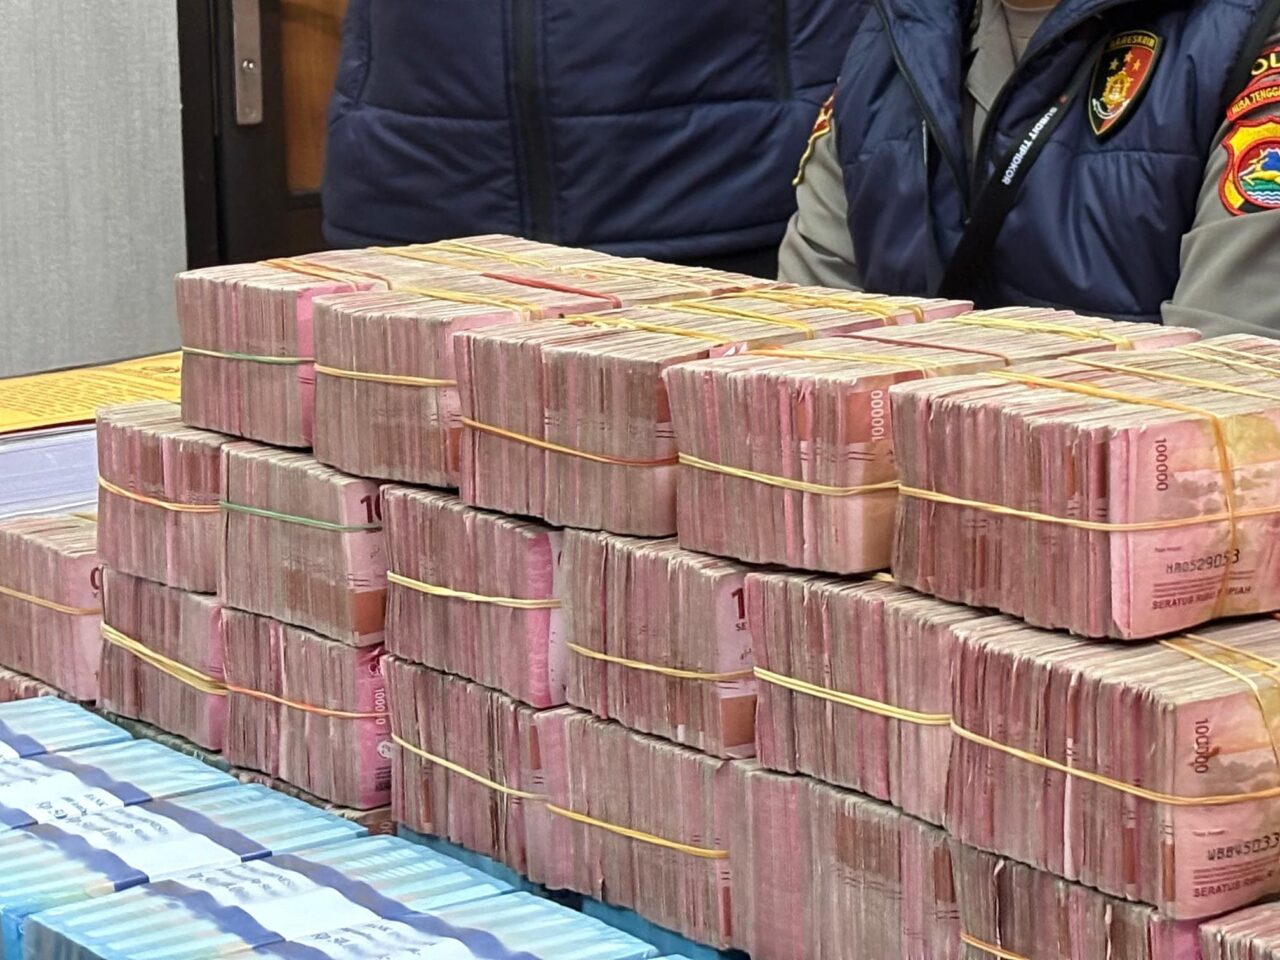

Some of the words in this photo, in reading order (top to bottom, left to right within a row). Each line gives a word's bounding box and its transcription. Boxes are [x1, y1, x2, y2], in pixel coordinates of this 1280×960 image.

[1028, 106, 1058, 140] SUBDIT
[1231, 96, 1251, 115] NUSA
[1001, 139, 1033, 186] TIPIDKOR
[870, 389, 885, 442] 100000
[1155, 437, 1169, 492] 100000
[374, 687, 386, 725] 10000
